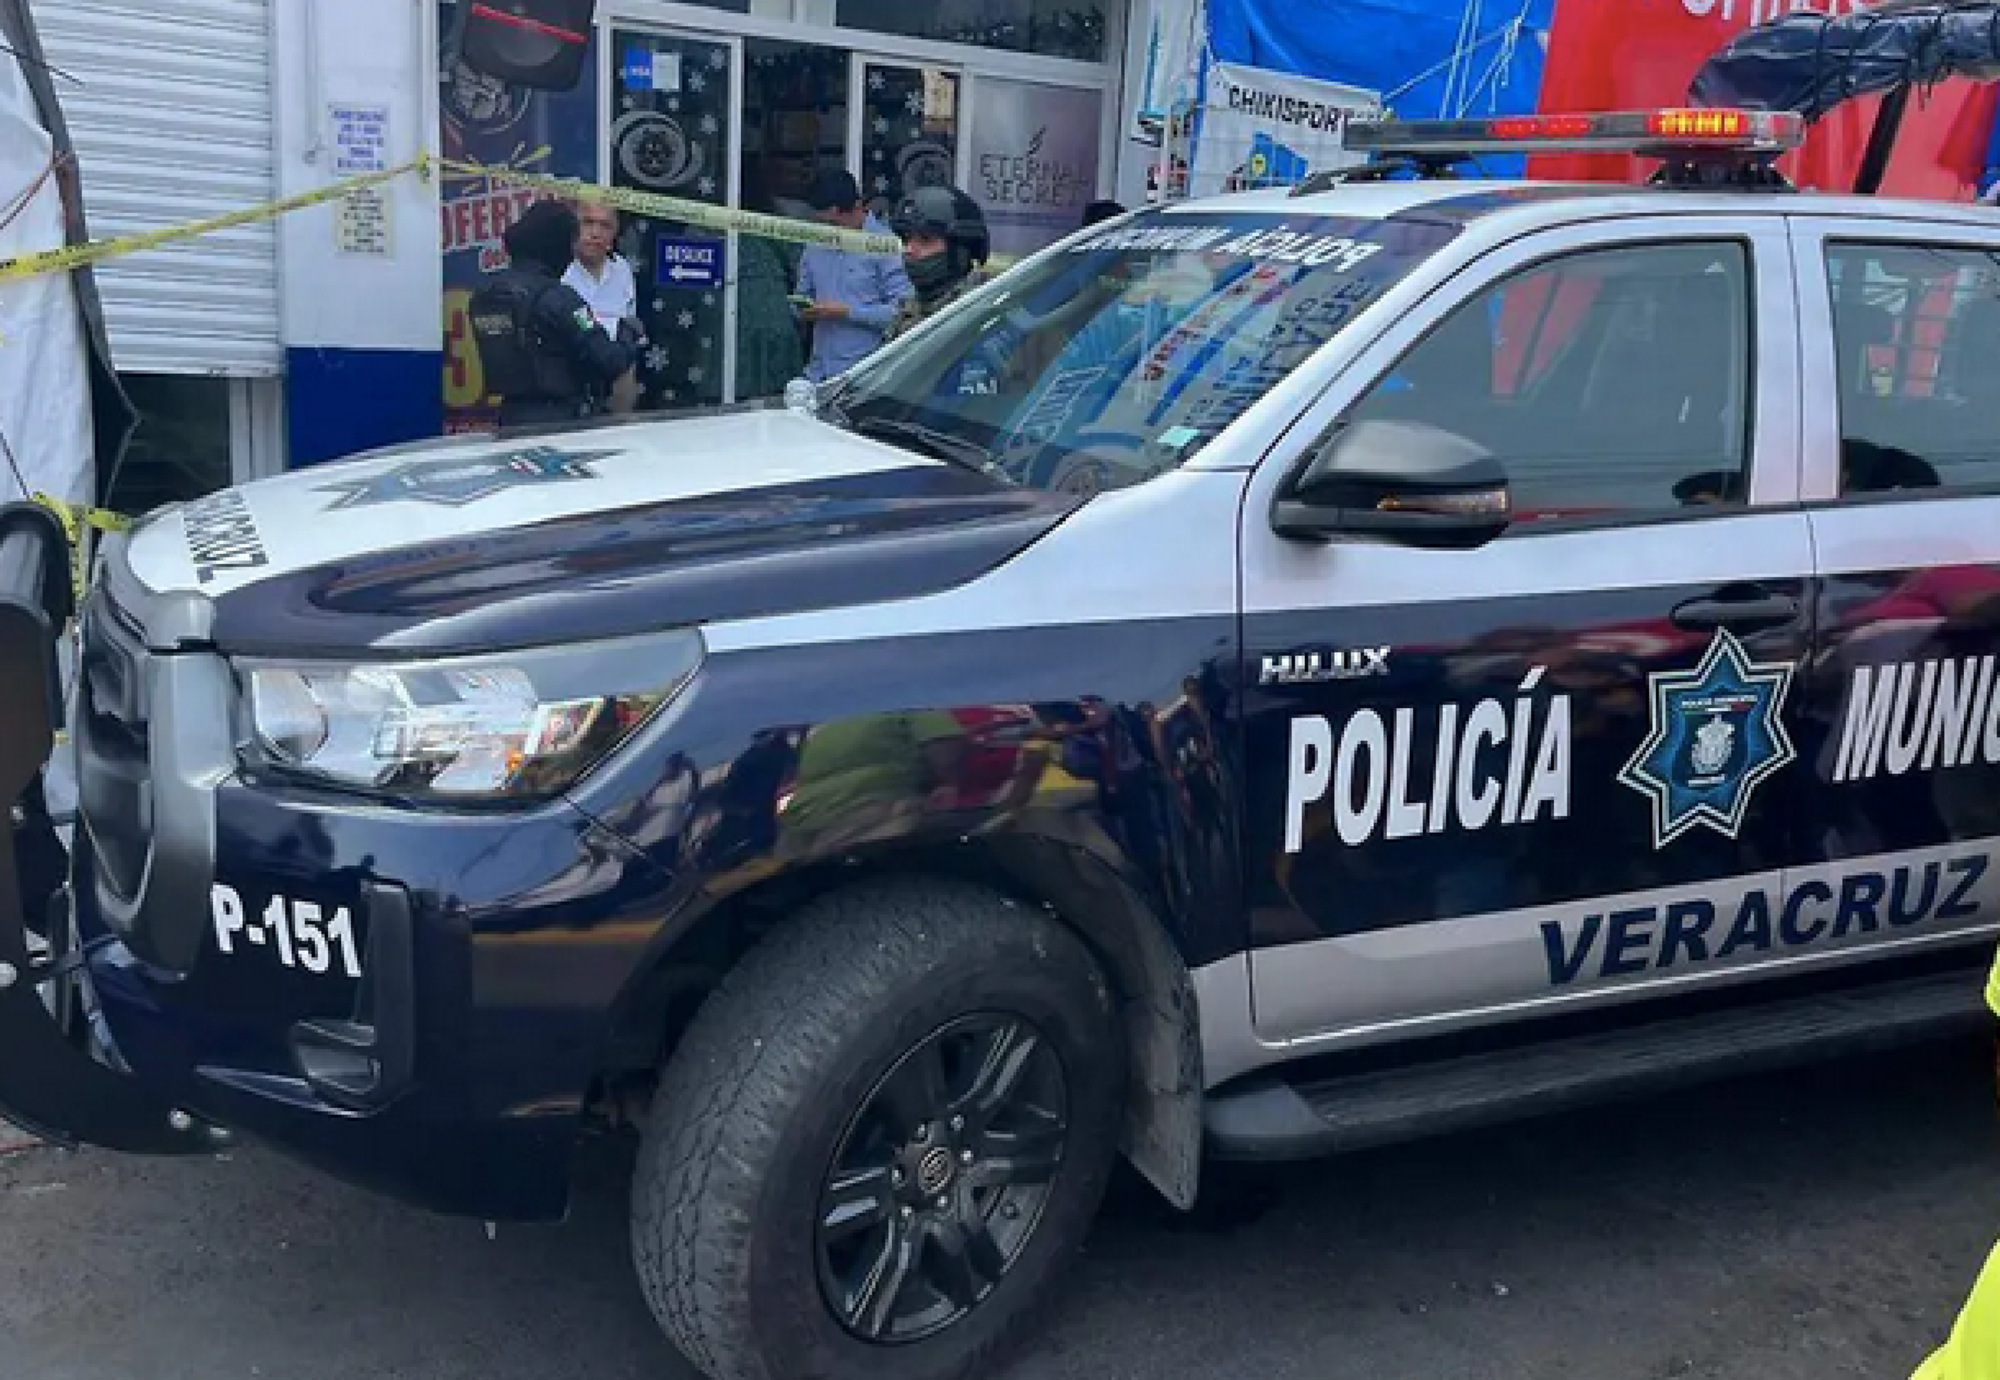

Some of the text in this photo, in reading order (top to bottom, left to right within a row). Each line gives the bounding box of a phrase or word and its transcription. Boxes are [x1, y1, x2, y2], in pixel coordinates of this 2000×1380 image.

[1258, 645, 1391, 684] HILUX
[1284, 665, 1571, 853] POLICÍA
[210, 877, 361, 977] P-151
[1539, 853, 1989, 985] VERACRUZ
